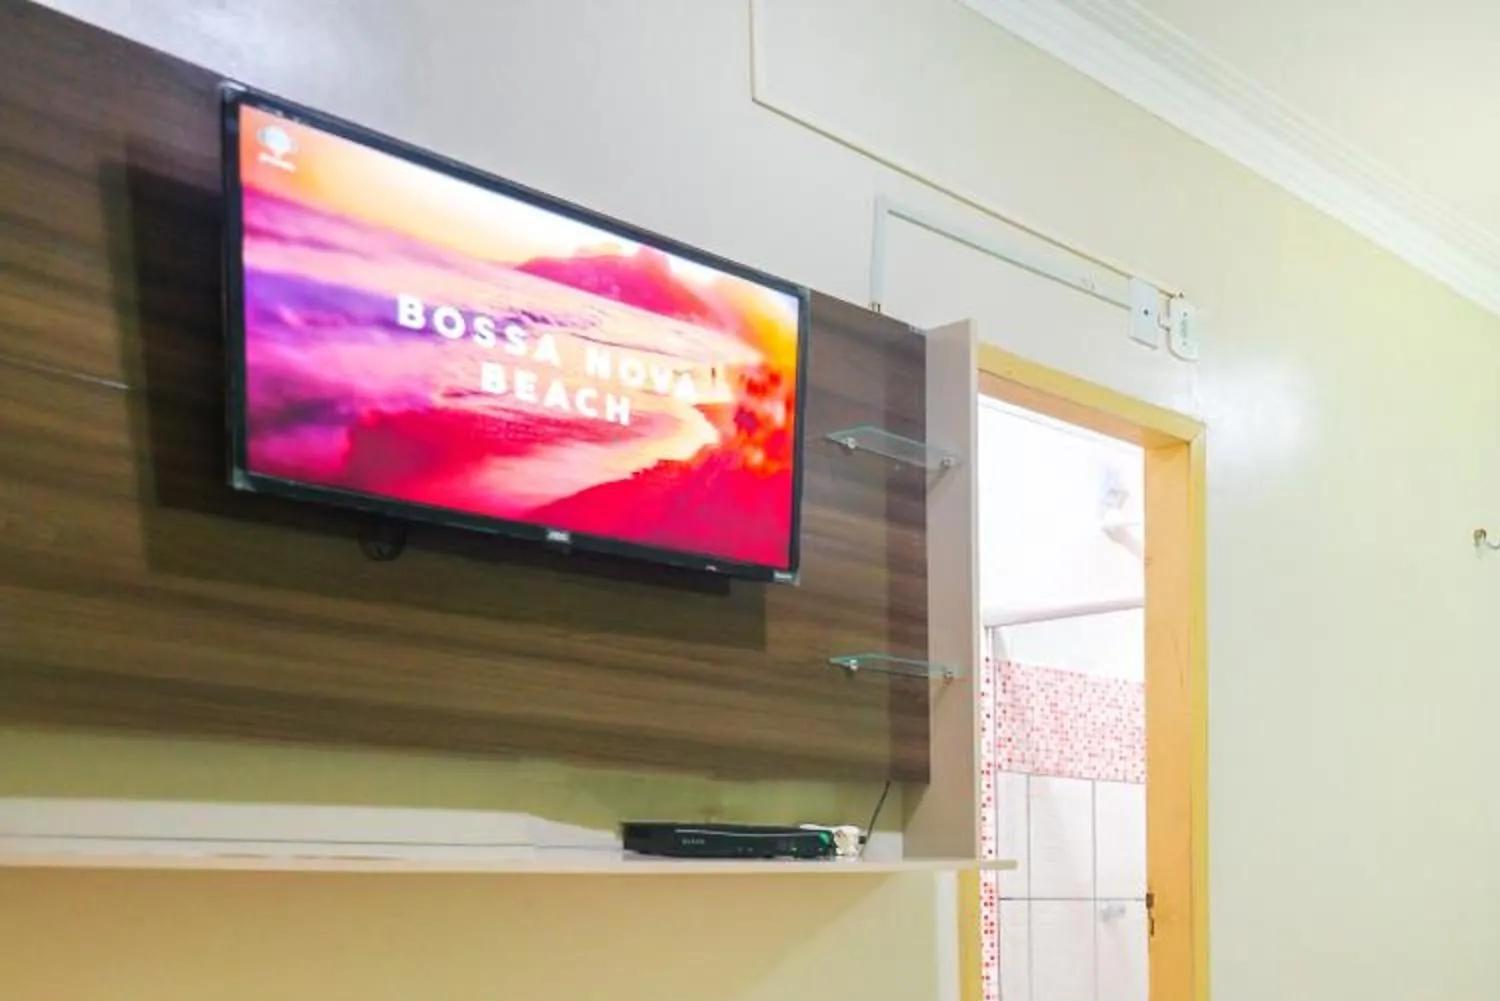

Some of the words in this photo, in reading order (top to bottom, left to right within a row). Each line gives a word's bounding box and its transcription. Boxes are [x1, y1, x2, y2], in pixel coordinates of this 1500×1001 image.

[397, 293, 562, 367] BOSSA
[585, 345, 698, 402] NOVA
[481, 361, 631, 426] BEACH
